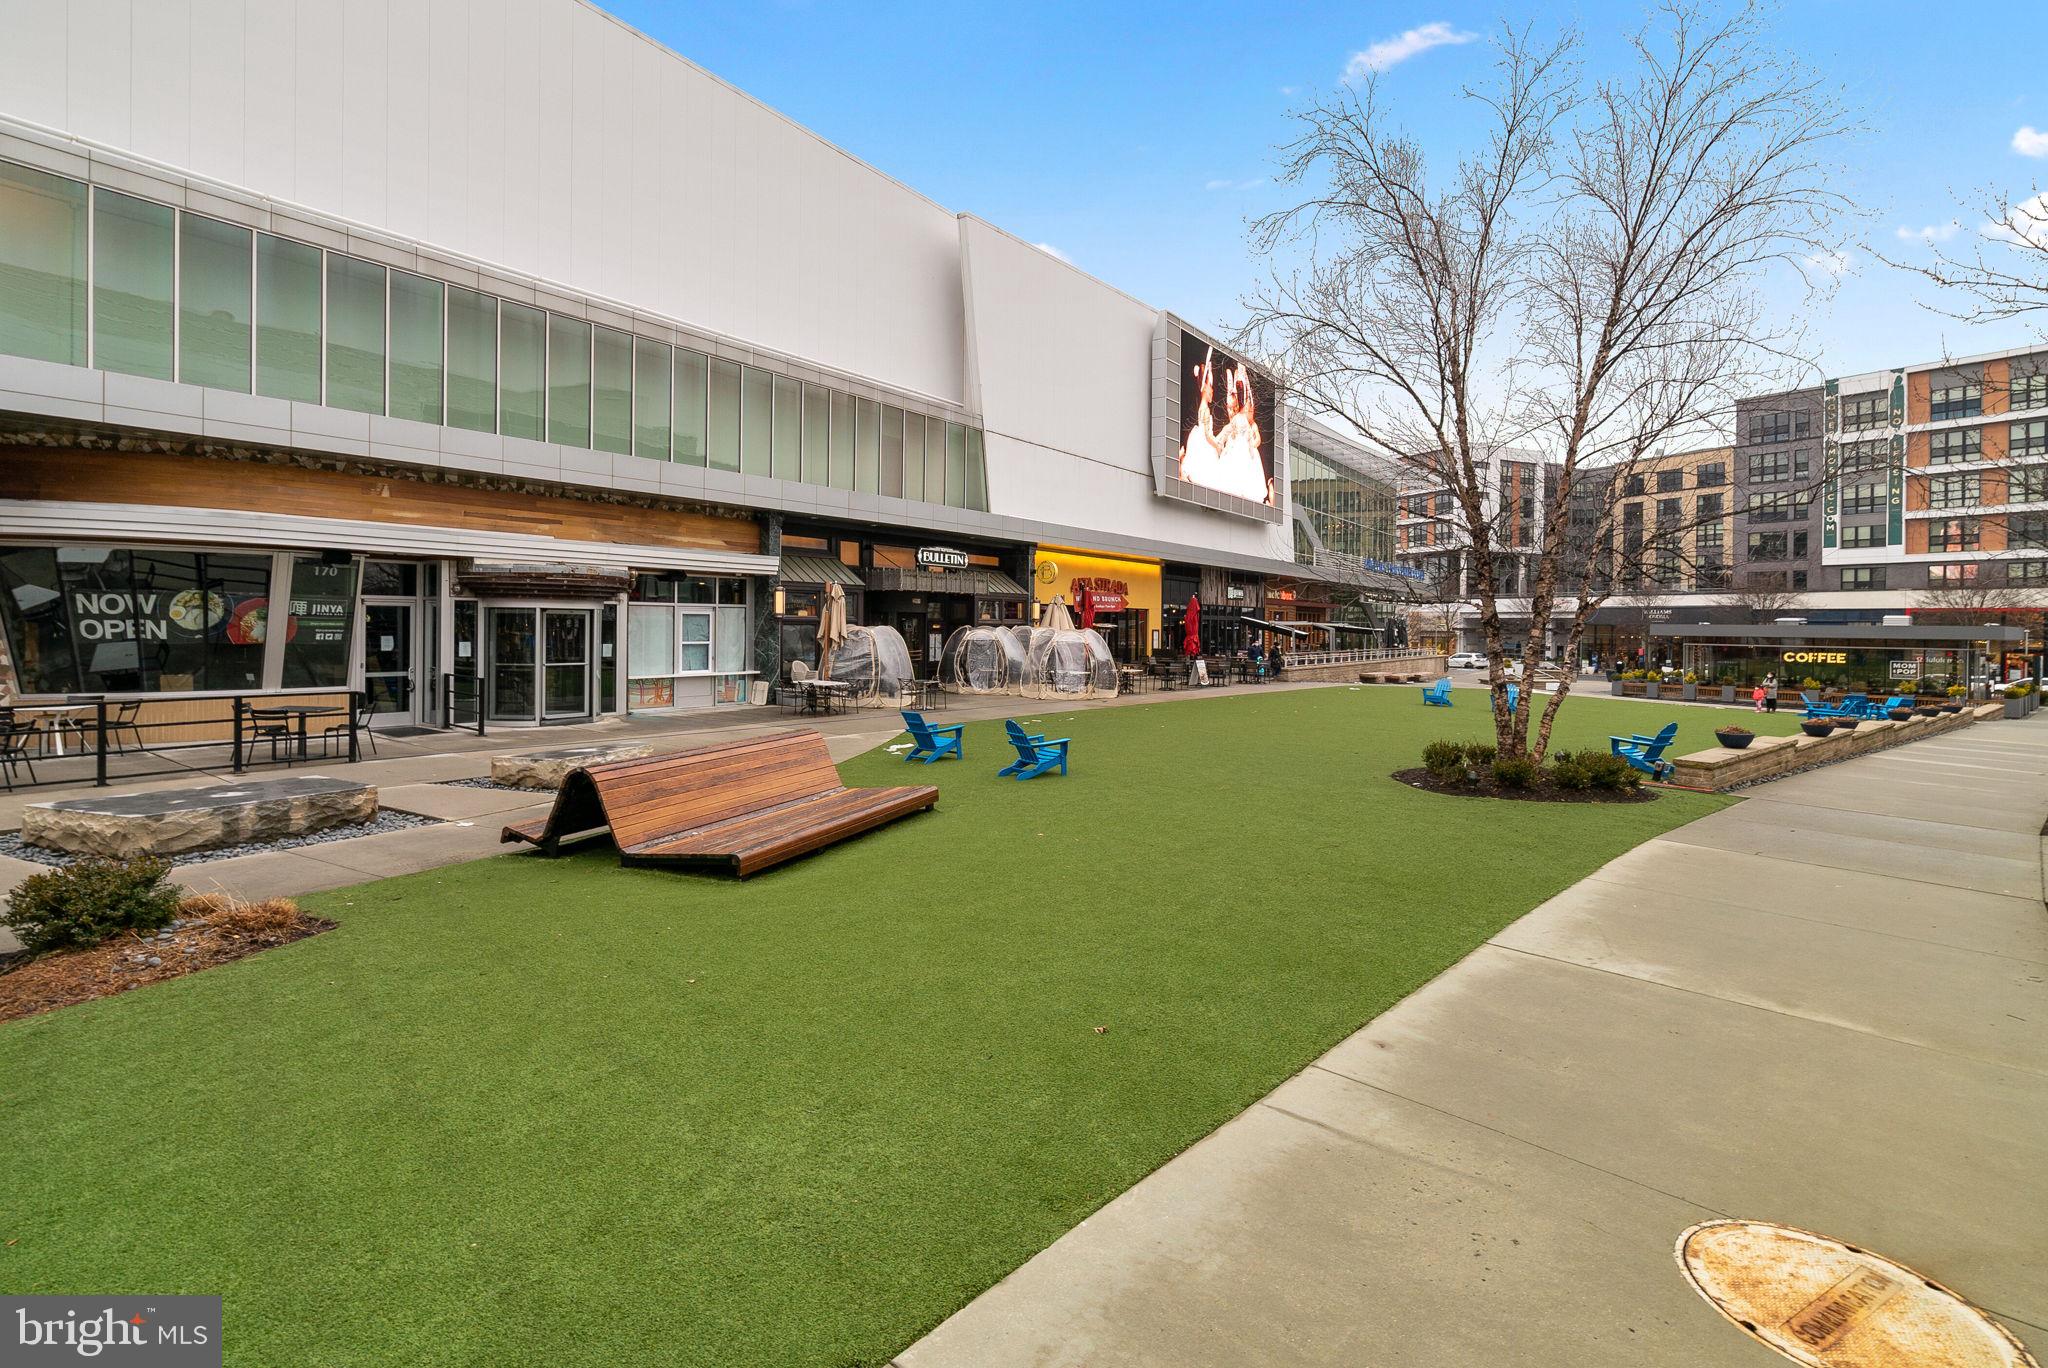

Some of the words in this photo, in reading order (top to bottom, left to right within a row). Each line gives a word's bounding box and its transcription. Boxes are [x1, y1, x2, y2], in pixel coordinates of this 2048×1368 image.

[922, 551, 964, 565] BULLETIN
[314, 566, 338, 577] 170
[1094, 577, 1129, 596] STRADA
[75, 593, 157, 615] NOW
[312, 604, 344, 615] JINYA
[79, 619, 168, 640] OPEN
[1783, 651, 1847, 664] COFFEE
